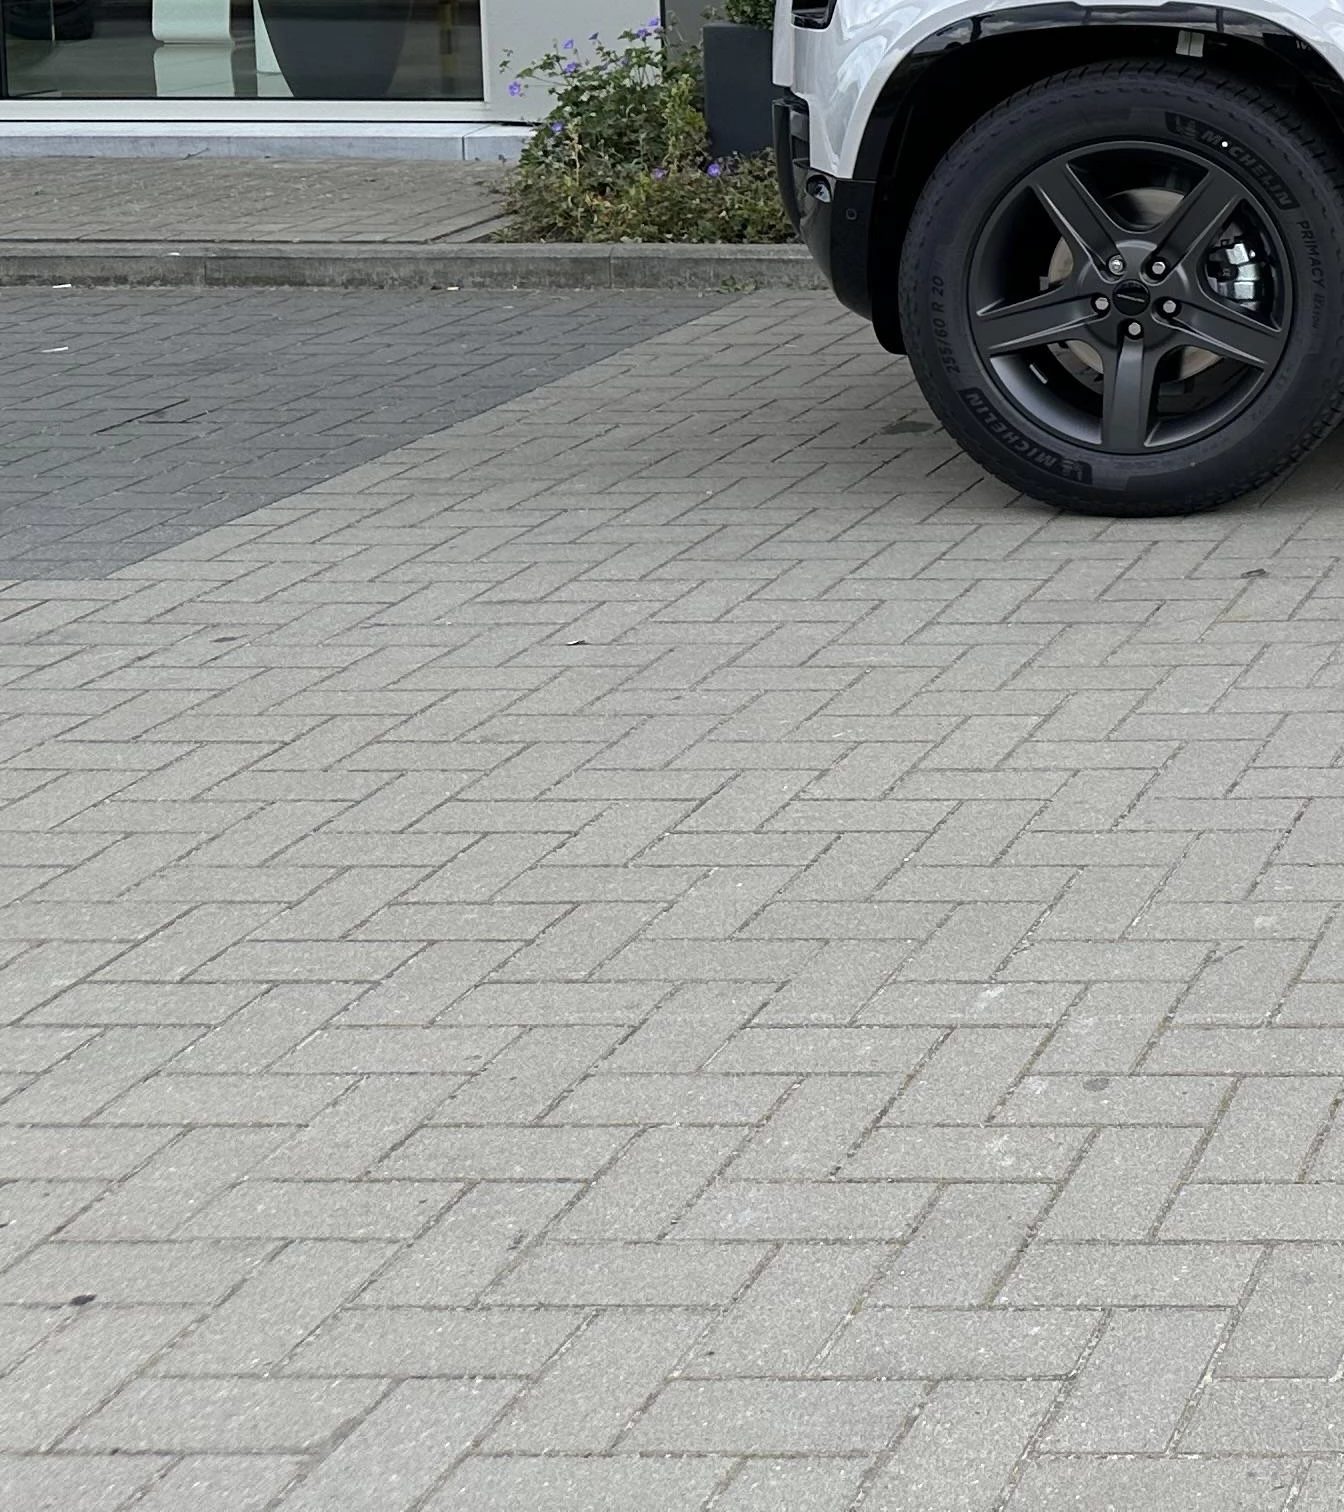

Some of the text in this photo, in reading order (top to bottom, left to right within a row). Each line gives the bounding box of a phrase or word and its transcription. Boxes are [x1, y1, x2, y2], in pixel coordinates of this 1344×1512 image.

[1200, 130, 1292, 206] MCHELIN
[1298, 220, 1325, 290] PRIMACY
[931, 275, 961, 375] 255/60 R 20
[964, 391, 1058, 472] MICHELIN
